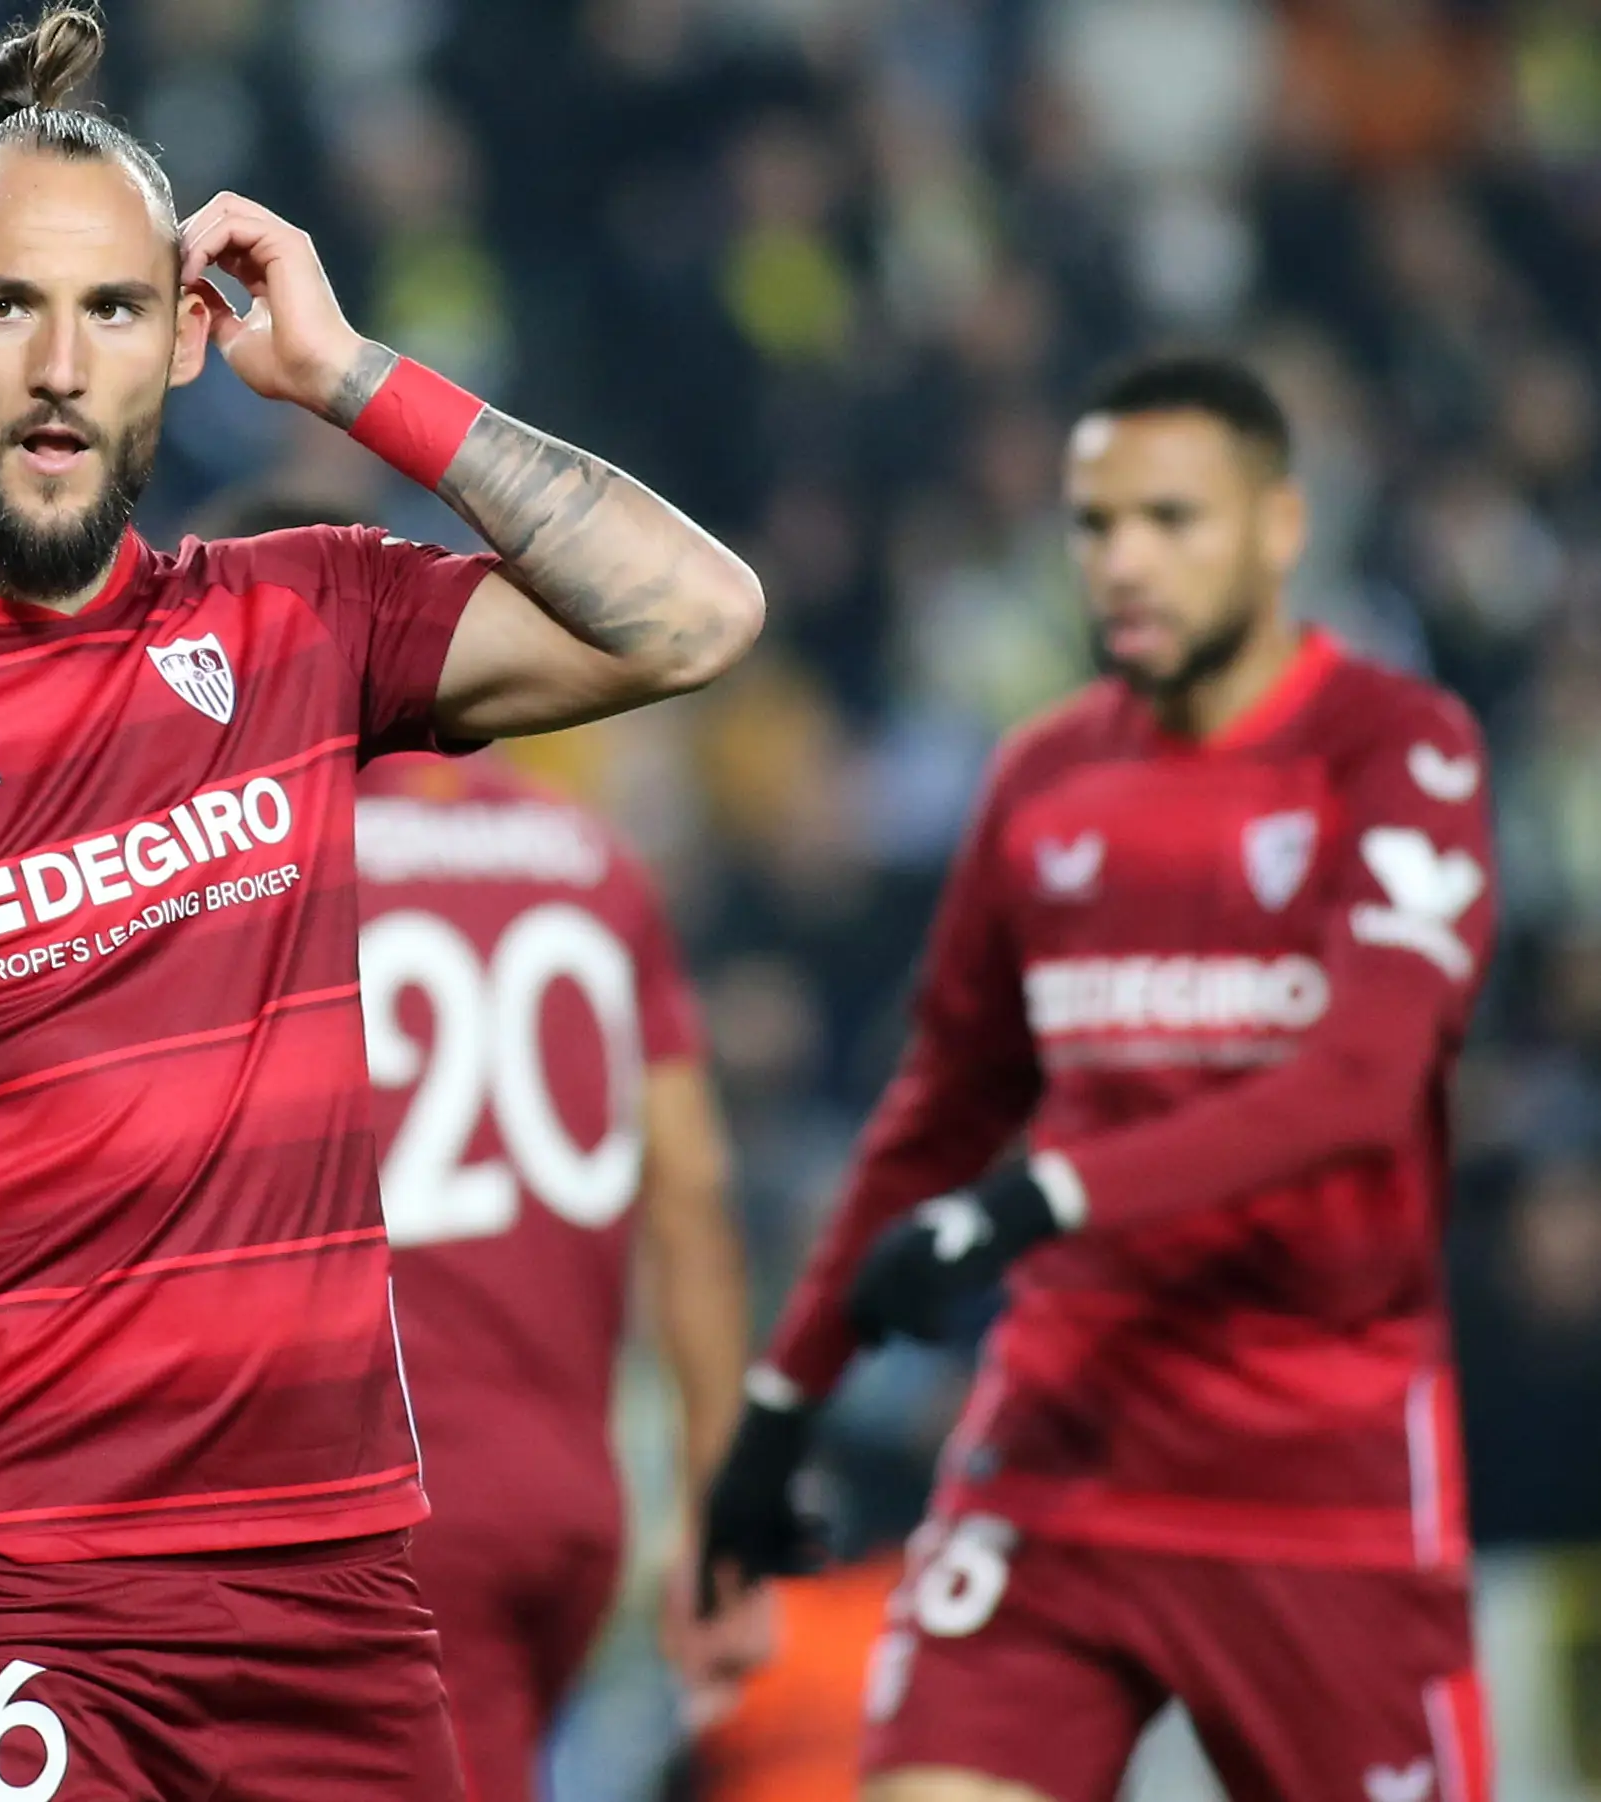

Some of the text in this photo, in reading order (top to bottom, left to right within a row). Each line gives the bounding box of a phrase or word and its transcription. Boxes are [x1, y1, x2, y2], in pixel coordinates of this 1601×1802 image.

[22, 777, 292, 923] DEGIRO
[95, 891, 200, 956] LEADING
[205, 863, 301, 911] BROKER
[359, 903, 647, 1249] 20
